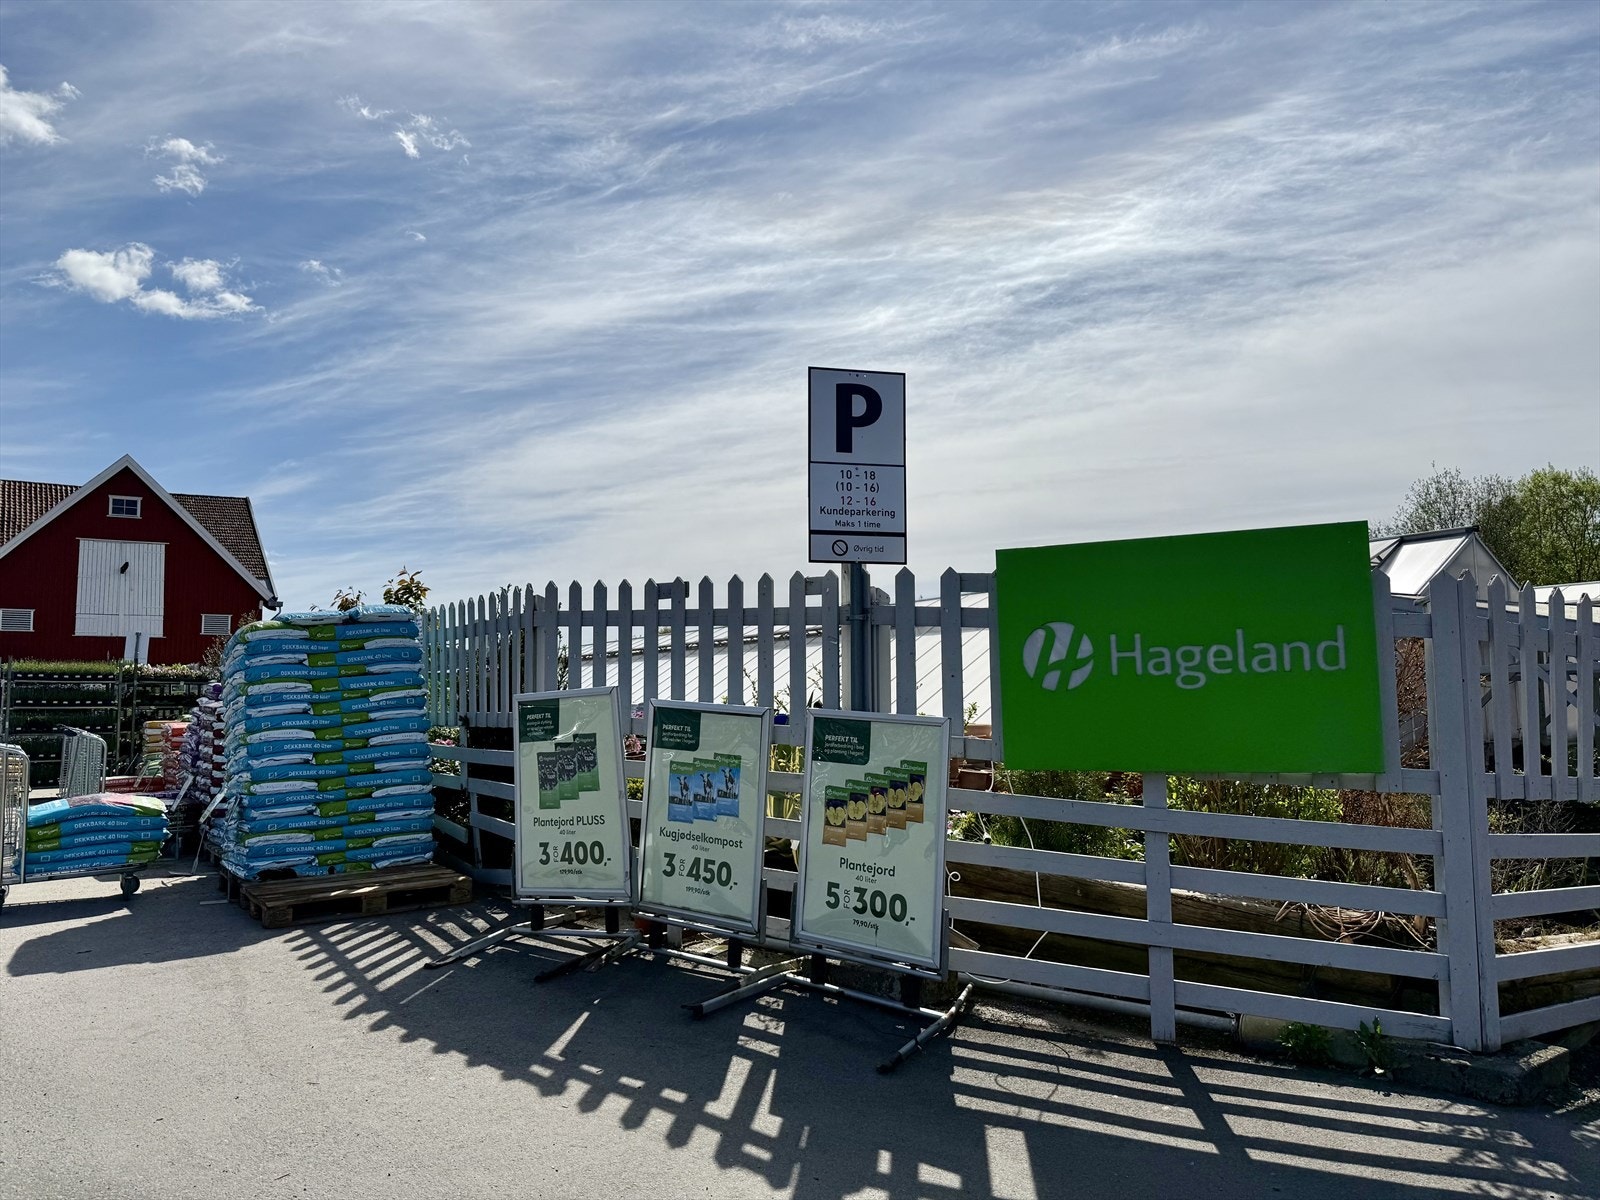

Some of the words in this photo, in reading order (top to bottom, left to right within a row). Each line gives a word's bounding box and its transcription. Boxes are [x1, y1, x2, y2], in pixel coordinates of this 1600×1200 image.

[836, 383, 882, 453] P
[840, 470, 852, 479] 10
[864, 471, 876, 480] 18
[836, 481, 852, 492] (10
[864, 482, 879, 493] 16)
[841, 496, 852, 505] 12
[864, 497, 876, 506] 16
[820, 506, 896, 519] Kundeparkering
[854, 545, 872, 553] Øvrig
[1110, 624, 1346, 689] Hageland
[534, 816, 574, 829] Plantejord
[577, 815, 605, 826] PLUSS
[659, 827, 743, 849] Kugjødselkompost
[539, 842, 550, 865] 3
[560, 841, 611, 866] 400,-
[662, 852, 676, 877] 3
[686, 857, 738, 890] 450,-
[840, 857, 895, 877] Plantejord
[825, 881, 840, 909] 5
[852, 886, 916, 926] 300,-
[853, 919, 879, 930] 79,90/stk
